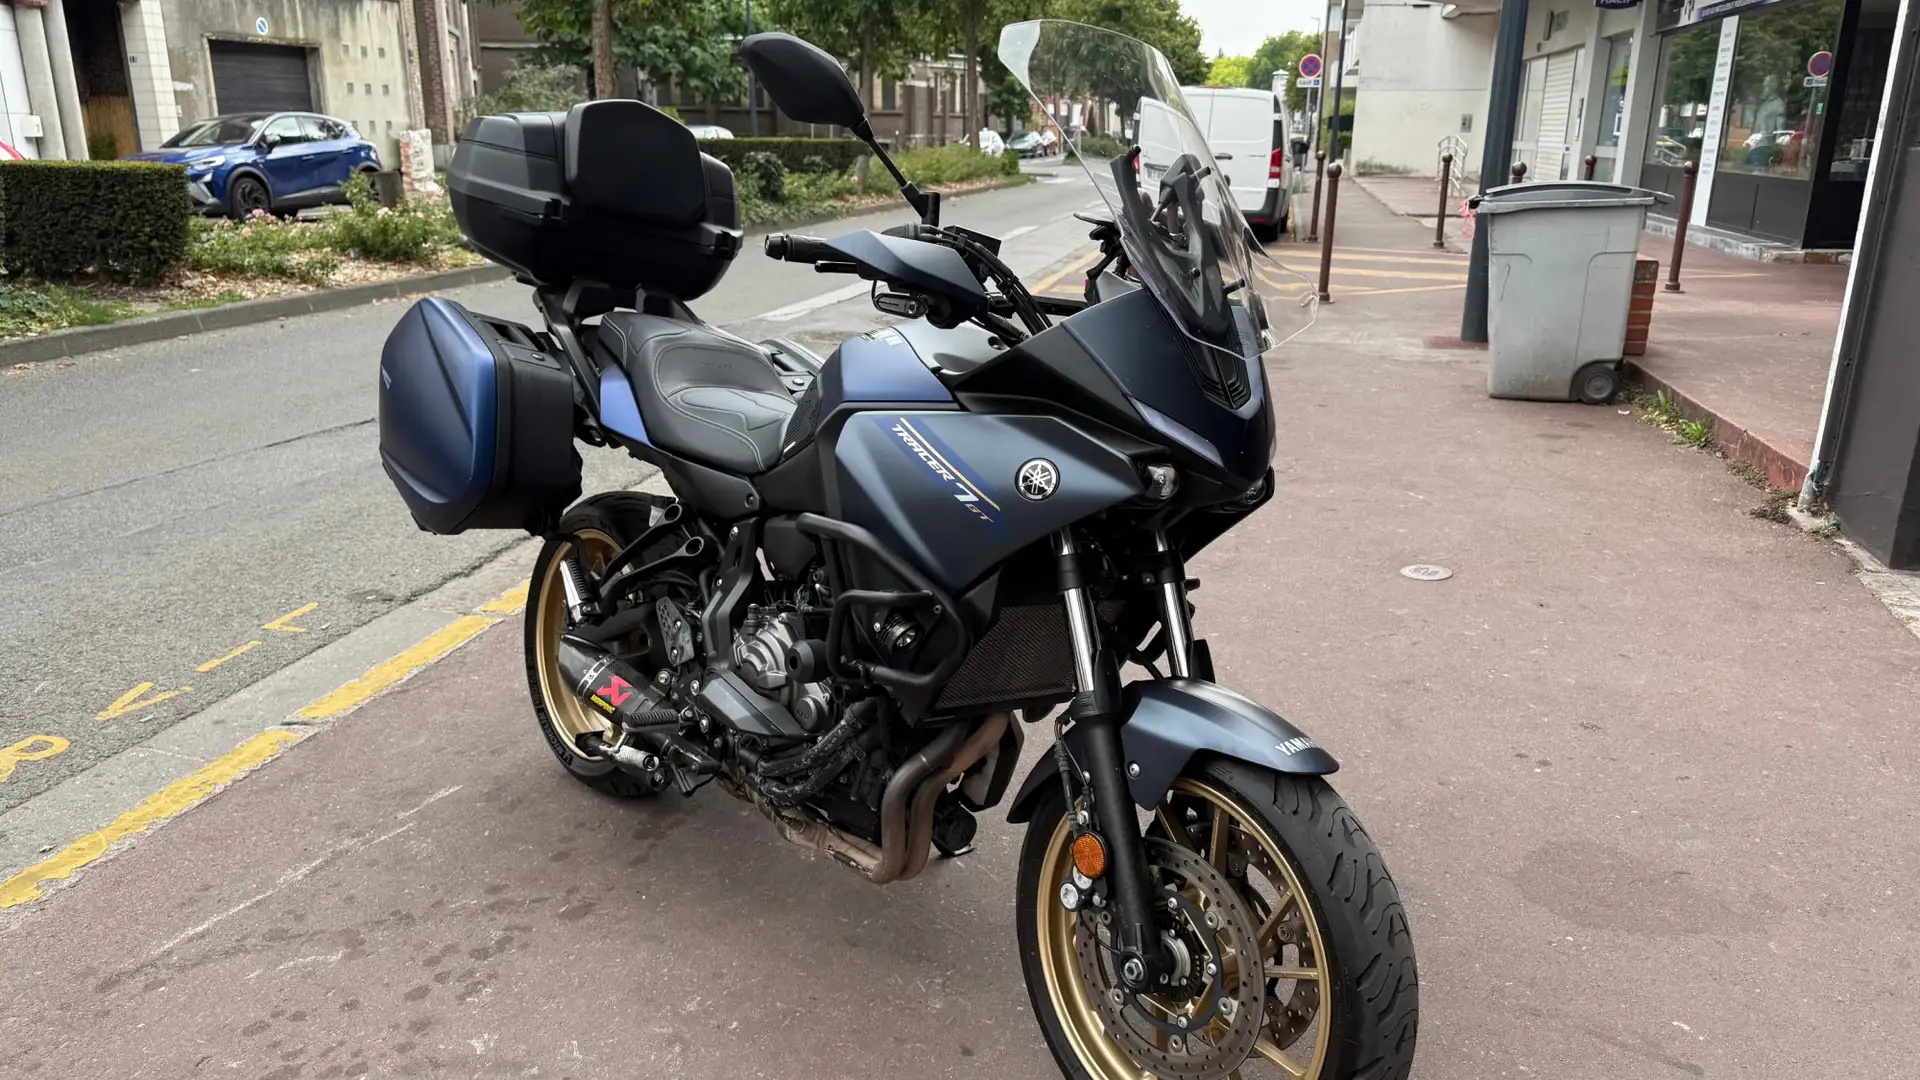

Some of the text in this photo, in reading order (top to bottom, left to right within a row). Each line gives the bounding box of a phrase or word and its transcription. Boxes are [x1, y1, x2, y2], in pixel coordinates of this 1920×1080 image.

[892, 424, 994, 523] TRACER 7 GT
[1275, 737, 1321, 756] YAMA
